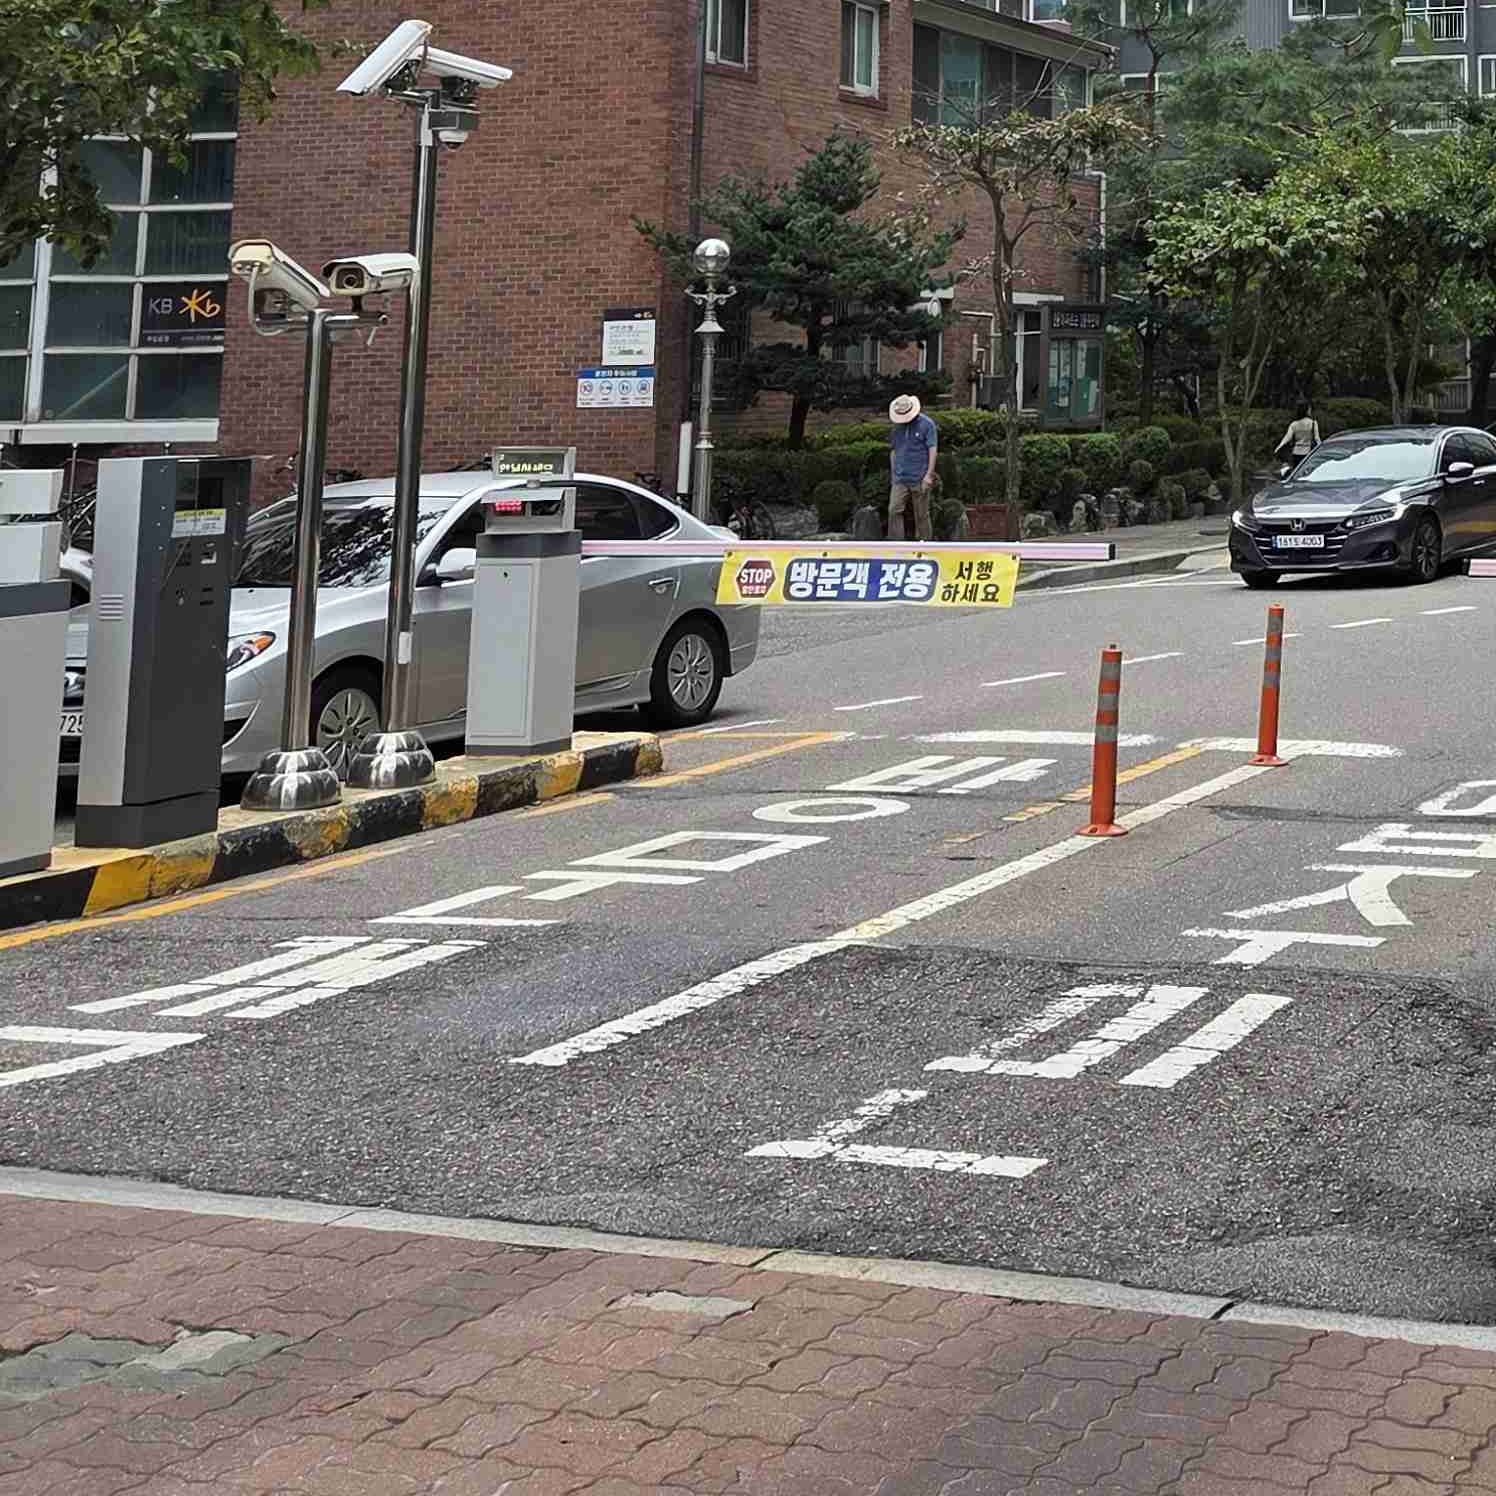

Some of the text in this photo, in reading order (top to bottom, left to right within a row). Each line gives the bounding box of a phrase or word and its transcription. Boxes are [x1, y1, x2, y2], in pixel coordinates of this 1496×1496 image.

[149, 297, 173, 314] KB
[740, 568, 772, 584] STOP
[789, 561, 931, 599] 방문객 전용
[954, 560, 993, 581] 서행
[941, 582, 1001, 603] 하세요
